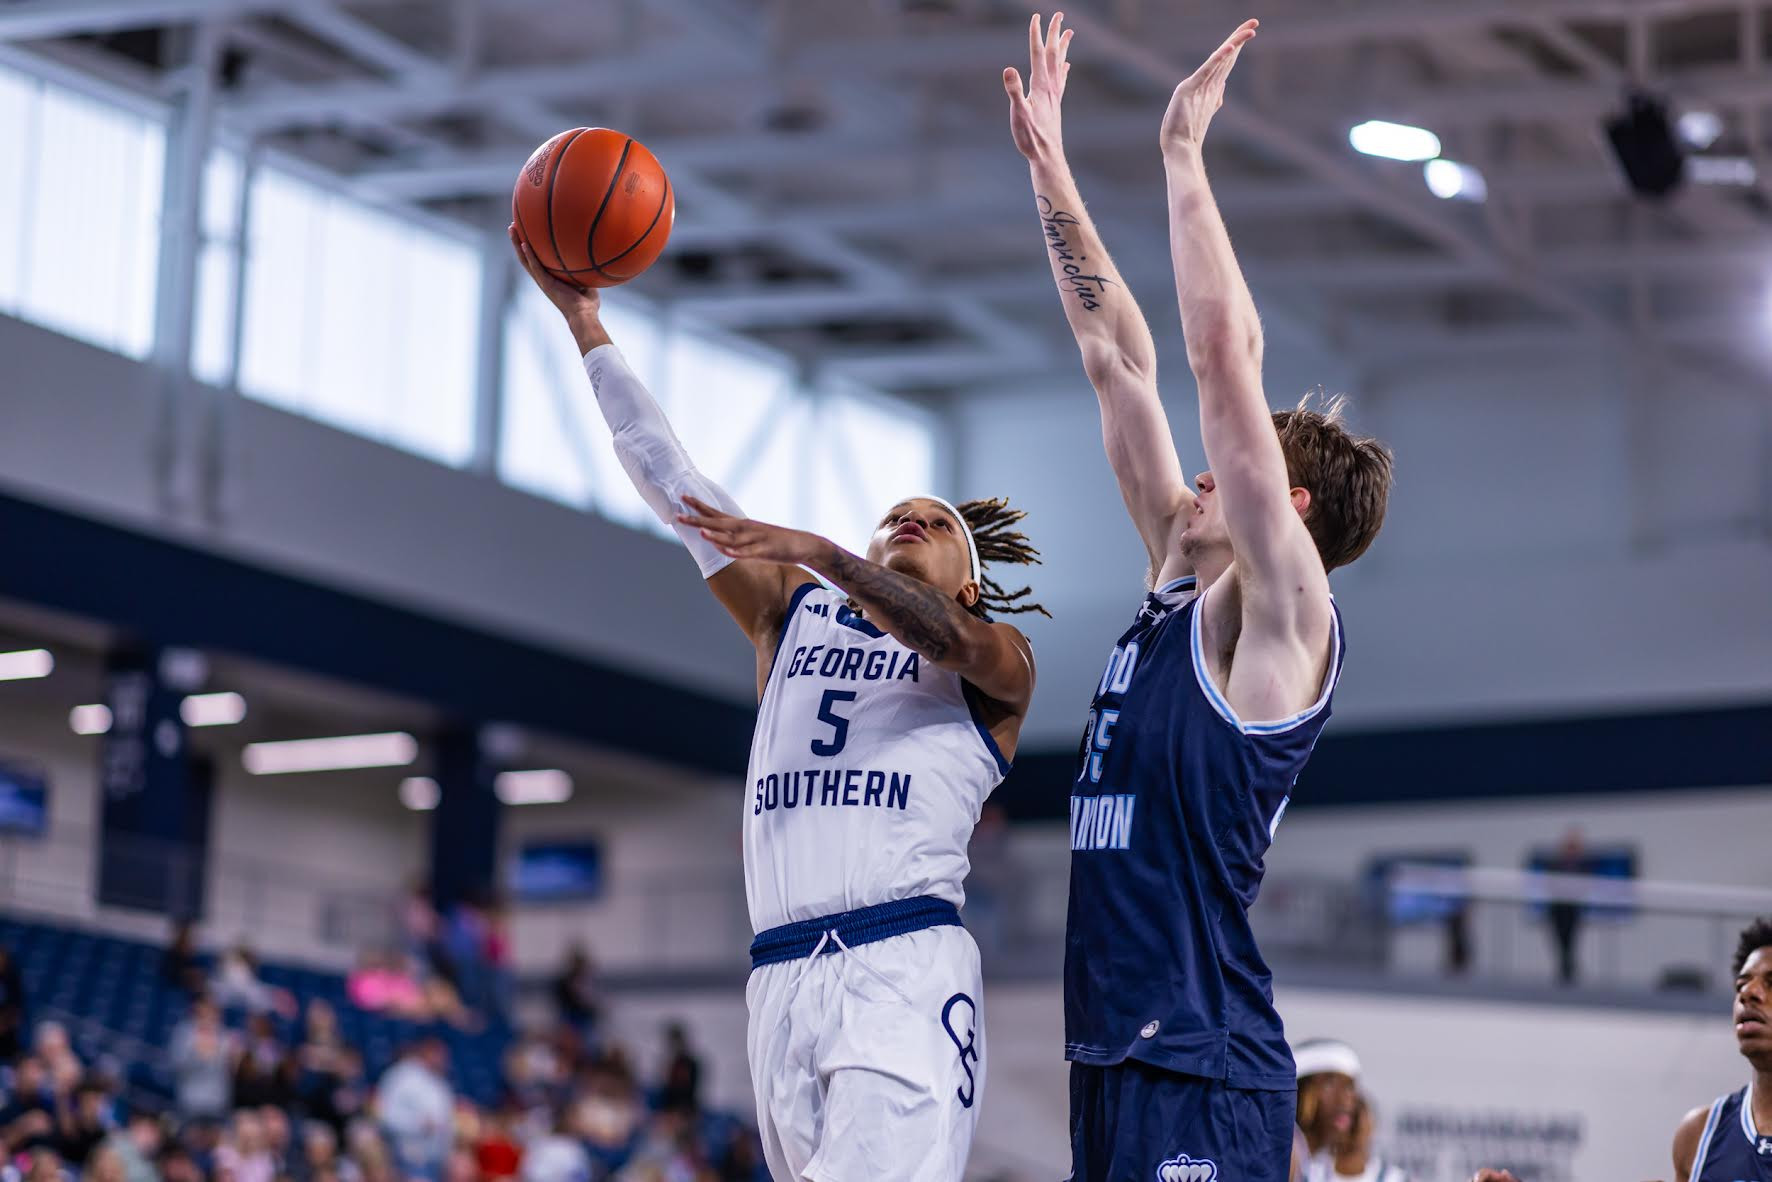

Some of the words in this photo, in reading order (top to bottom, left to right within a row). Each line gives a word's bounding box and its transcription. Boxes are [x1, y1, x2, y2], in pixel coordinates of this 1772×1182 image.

[1037, 195, 1120, 312] Invictus
[787, 645, 919, 682] GEORGIA
[810, 689, 857, 757] 5
[754, 770, 911, 816] SOUTHERN
